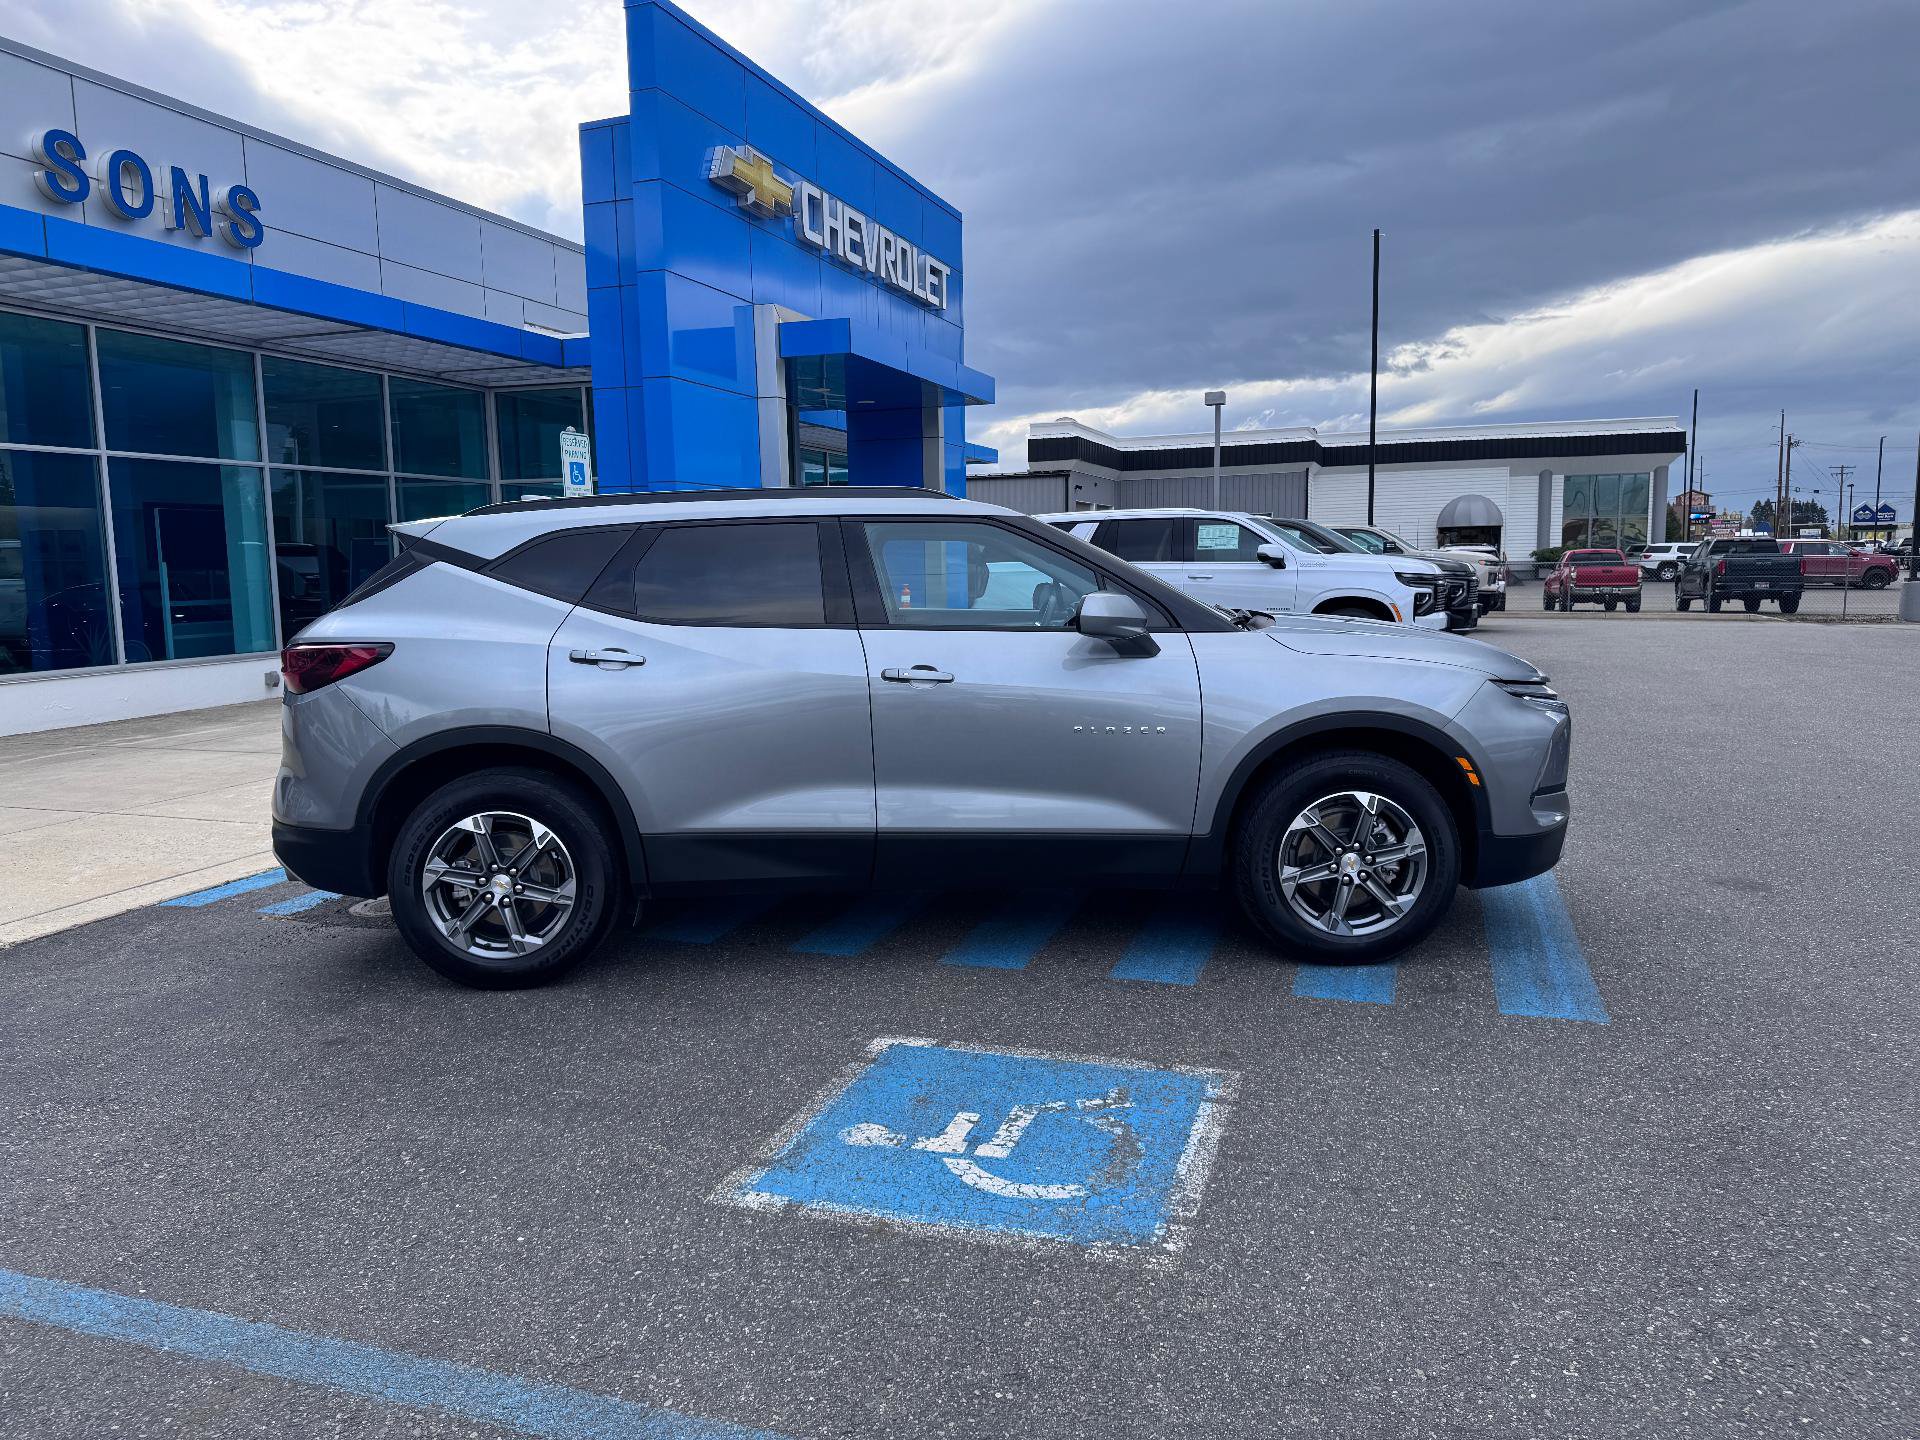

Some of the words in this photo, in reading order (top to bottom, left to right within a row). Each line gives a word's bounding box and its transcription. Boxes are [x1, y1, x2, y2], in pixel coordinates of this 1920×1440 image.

[35, 129, 264, 248] SONS
[794, 181, 951, 310] CHEVROLET
[1073, 725, 1166, 735] BLAZER
